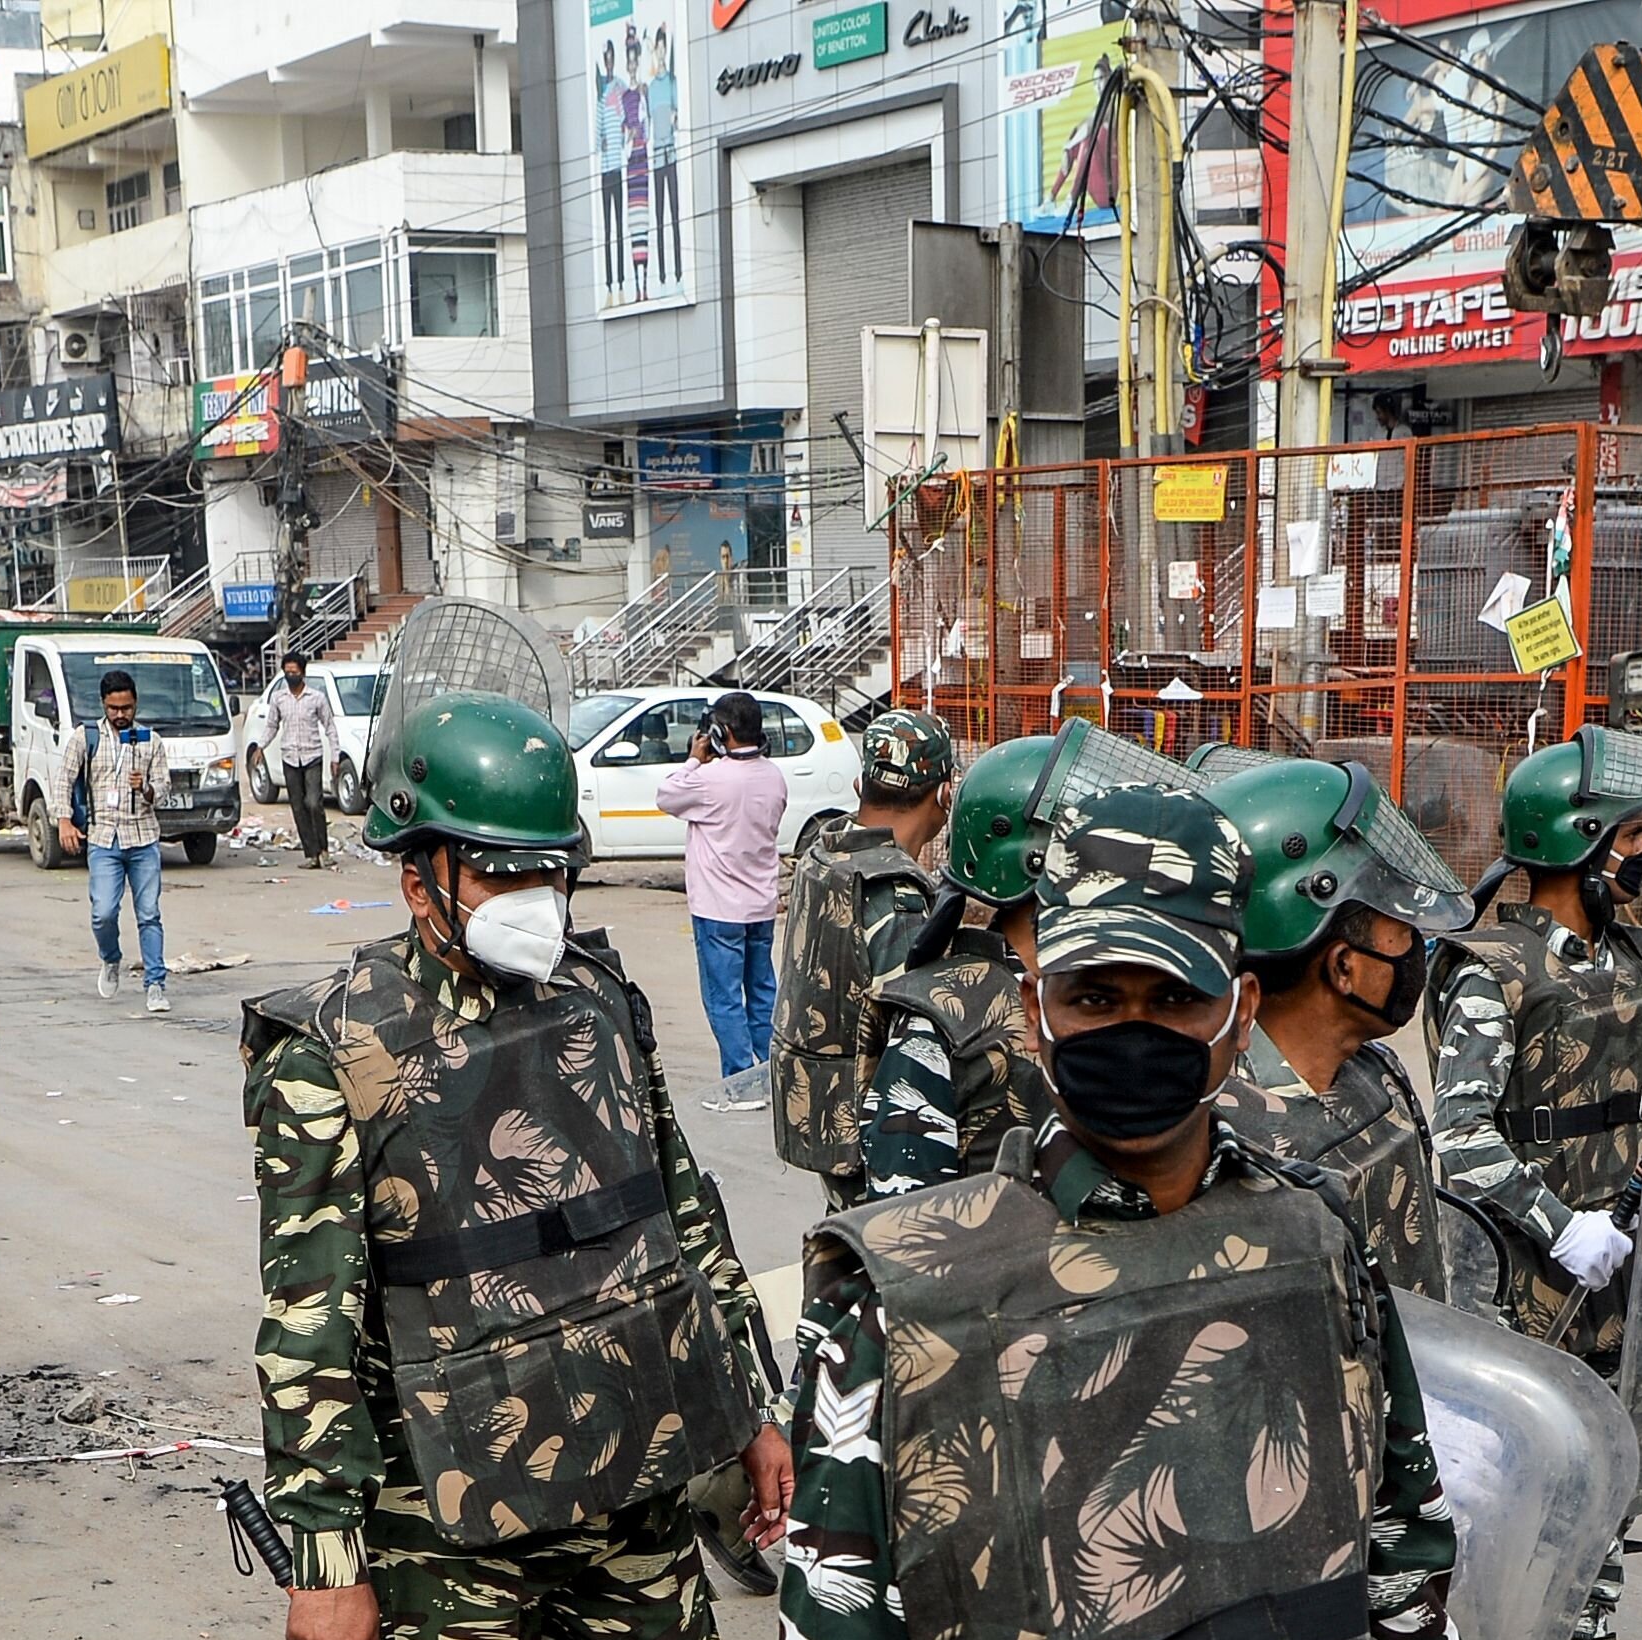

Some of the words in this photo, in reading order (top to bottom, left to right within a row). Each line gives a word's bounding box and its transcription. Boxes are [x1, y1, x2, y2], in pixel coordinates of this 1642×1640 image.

[814, 19, 840, 39] UNITED
[841, 12, 871, 33] COLORS
[903, 8, 970, 48] Clarks
[817, 43, 827, 57] OF
[828, 34, 866, 55] BENETTON
[1008, 66, 1076, 92] SKECHERS
[1013, 82, 1066, 105] SPORT
[1592, 149, 1628, 169] 2.2T
[1388, 333, 1447, 358] ONLINE
[1450, 326, 1512, 349] OUTLET
[38, 417, 74, 454] PRICE
[72, 412, 106, 450] SHOP
[589, 512, 625, 529] VANS
[226, 590, 258, 605] NUMERO
